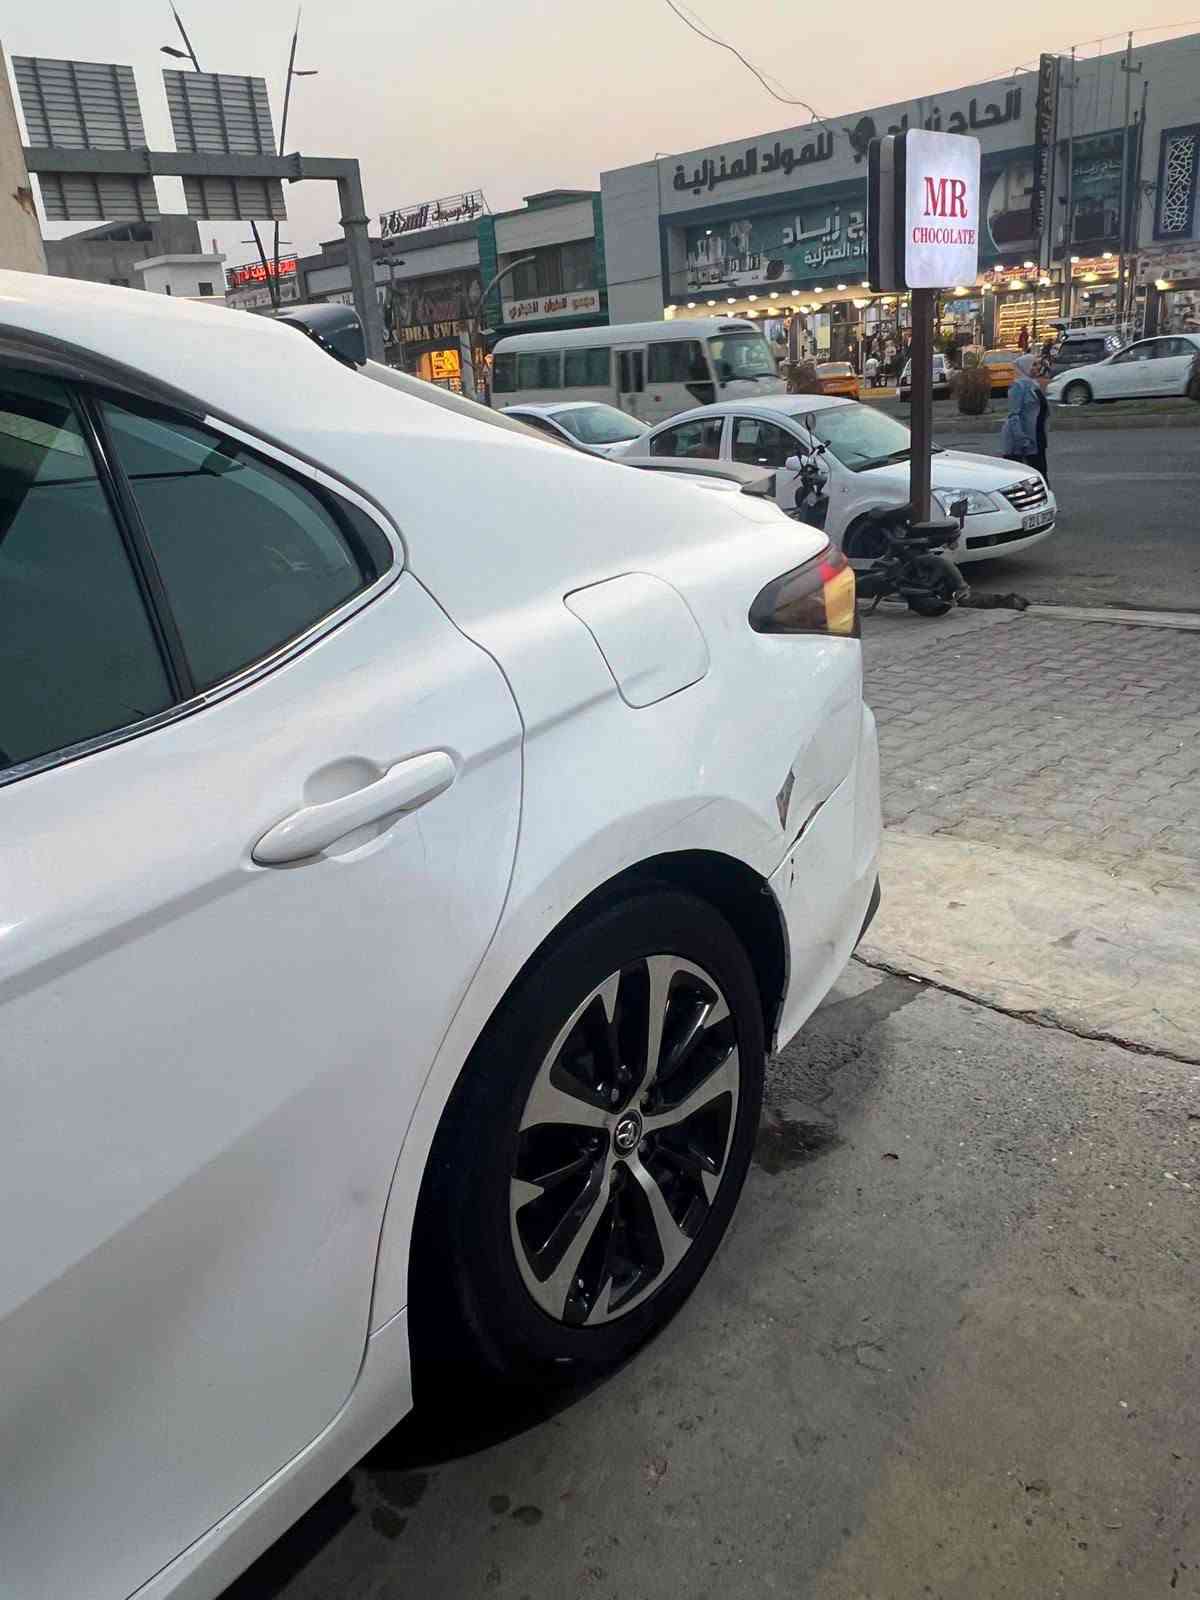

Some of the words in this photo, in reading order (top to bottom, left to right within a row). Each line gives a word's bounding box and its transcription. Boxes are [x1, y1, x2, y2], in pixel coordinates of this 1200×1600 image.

[948, 87, 1022, 134] الحاج
[673, 147, 758, 195] المنزلية
[763, 130, 834, 176] للمواد
[923, 176, 968, 219] MR
[782, 205, 841, 245] زياد
[912, 227, 976, 246] CHOCOLATE
[803, 244, 851, 269] المنزلية
